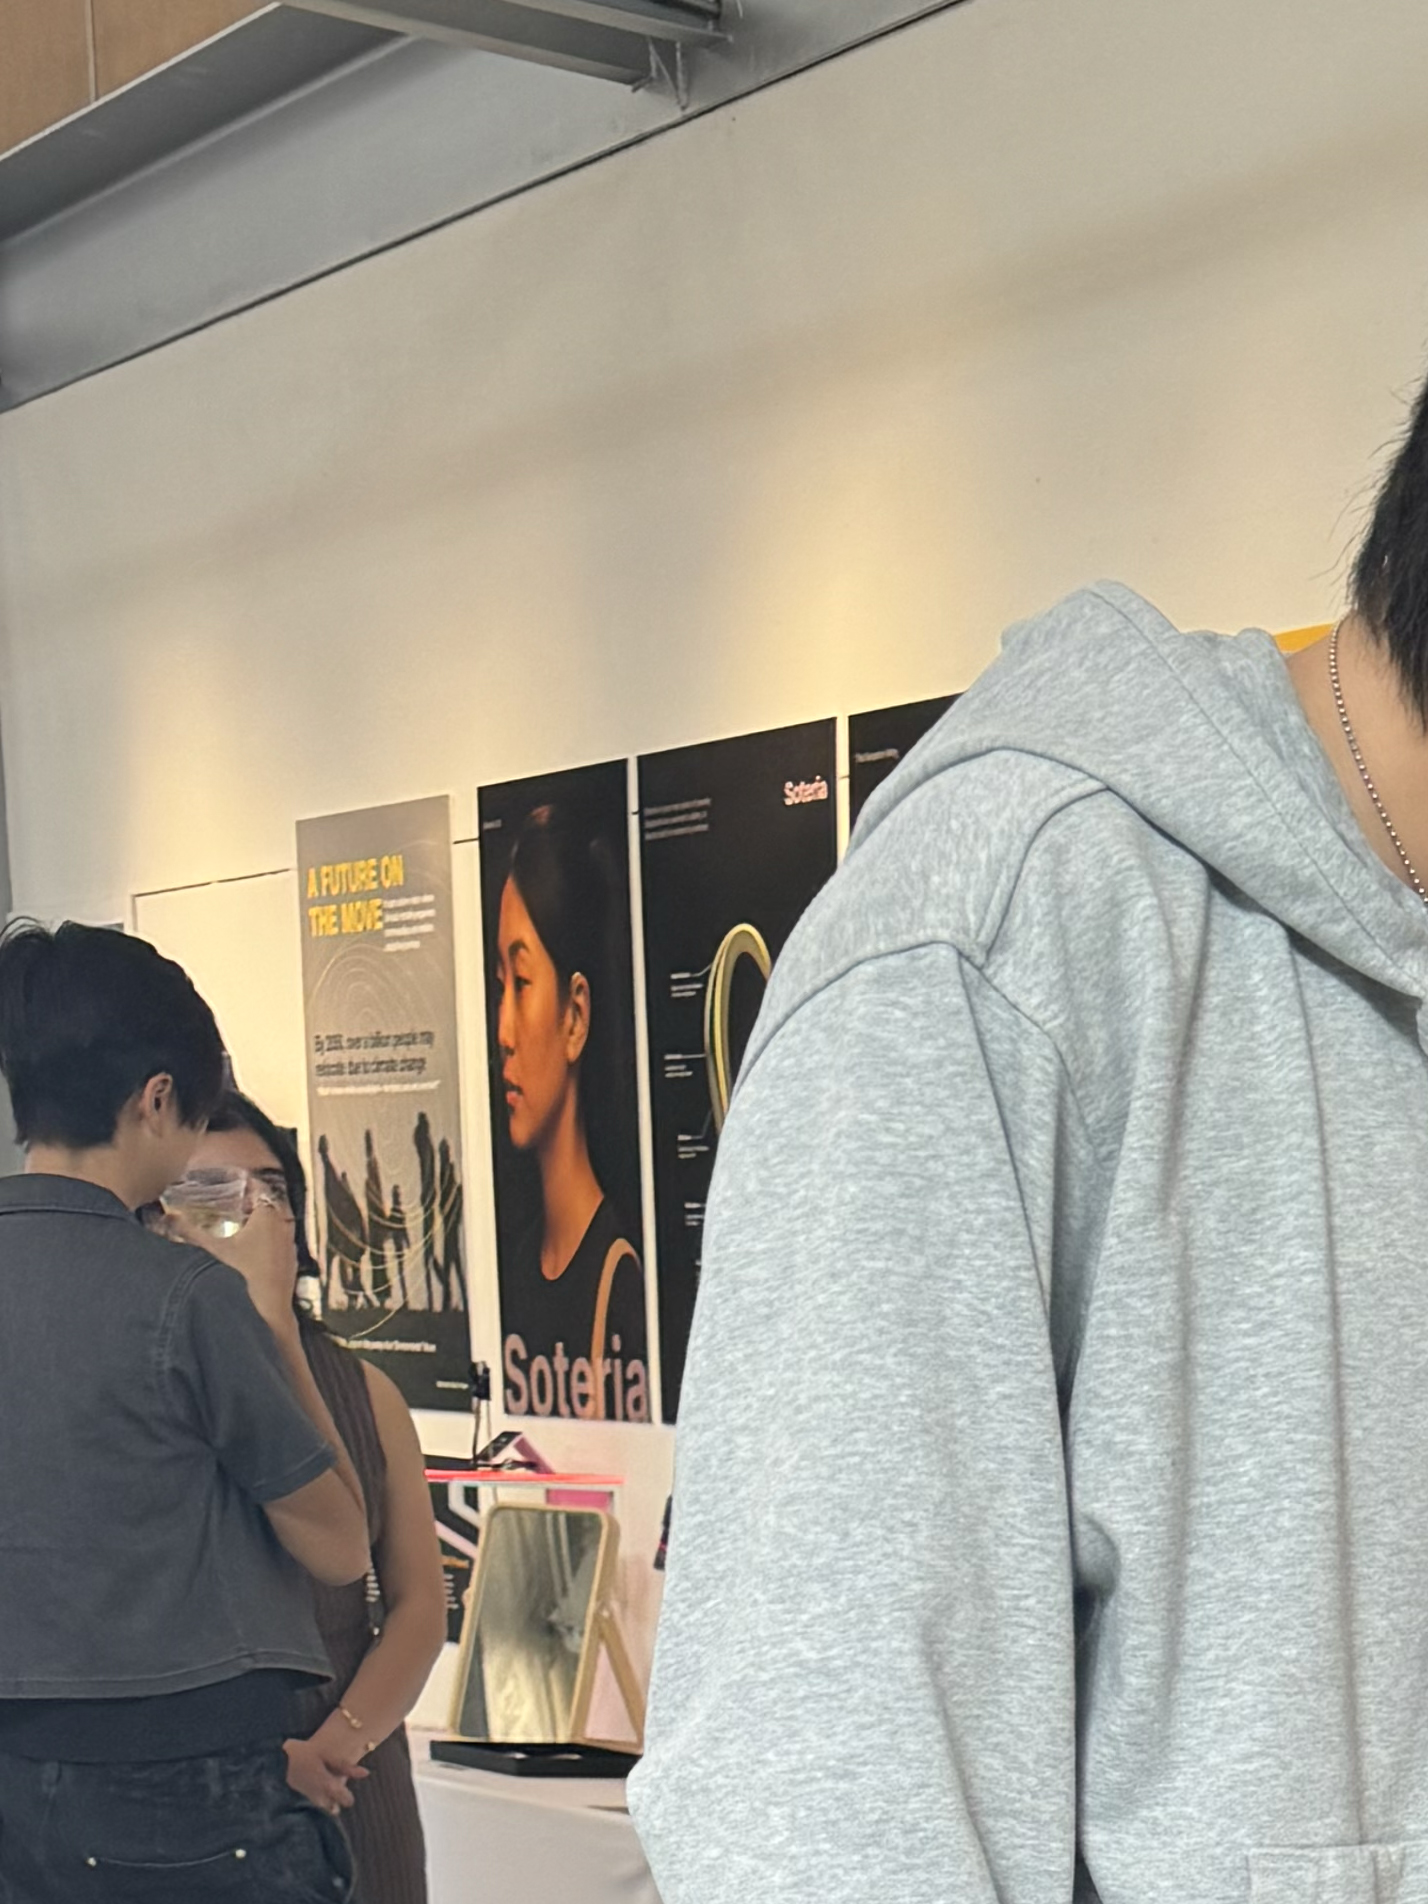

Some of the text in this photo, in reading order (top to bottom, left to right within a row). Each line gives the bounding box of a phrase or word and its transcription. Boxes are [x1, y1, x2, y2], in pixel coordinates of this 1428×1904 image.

[783, 774, 828, 806] Soteria
[306, 854, 404, 899] A FUTURE ON
[308, 904, 339, 938] THE
[341, 898, 384, 934] MOVE
[504, 1333, 650, 1423] Soteria
